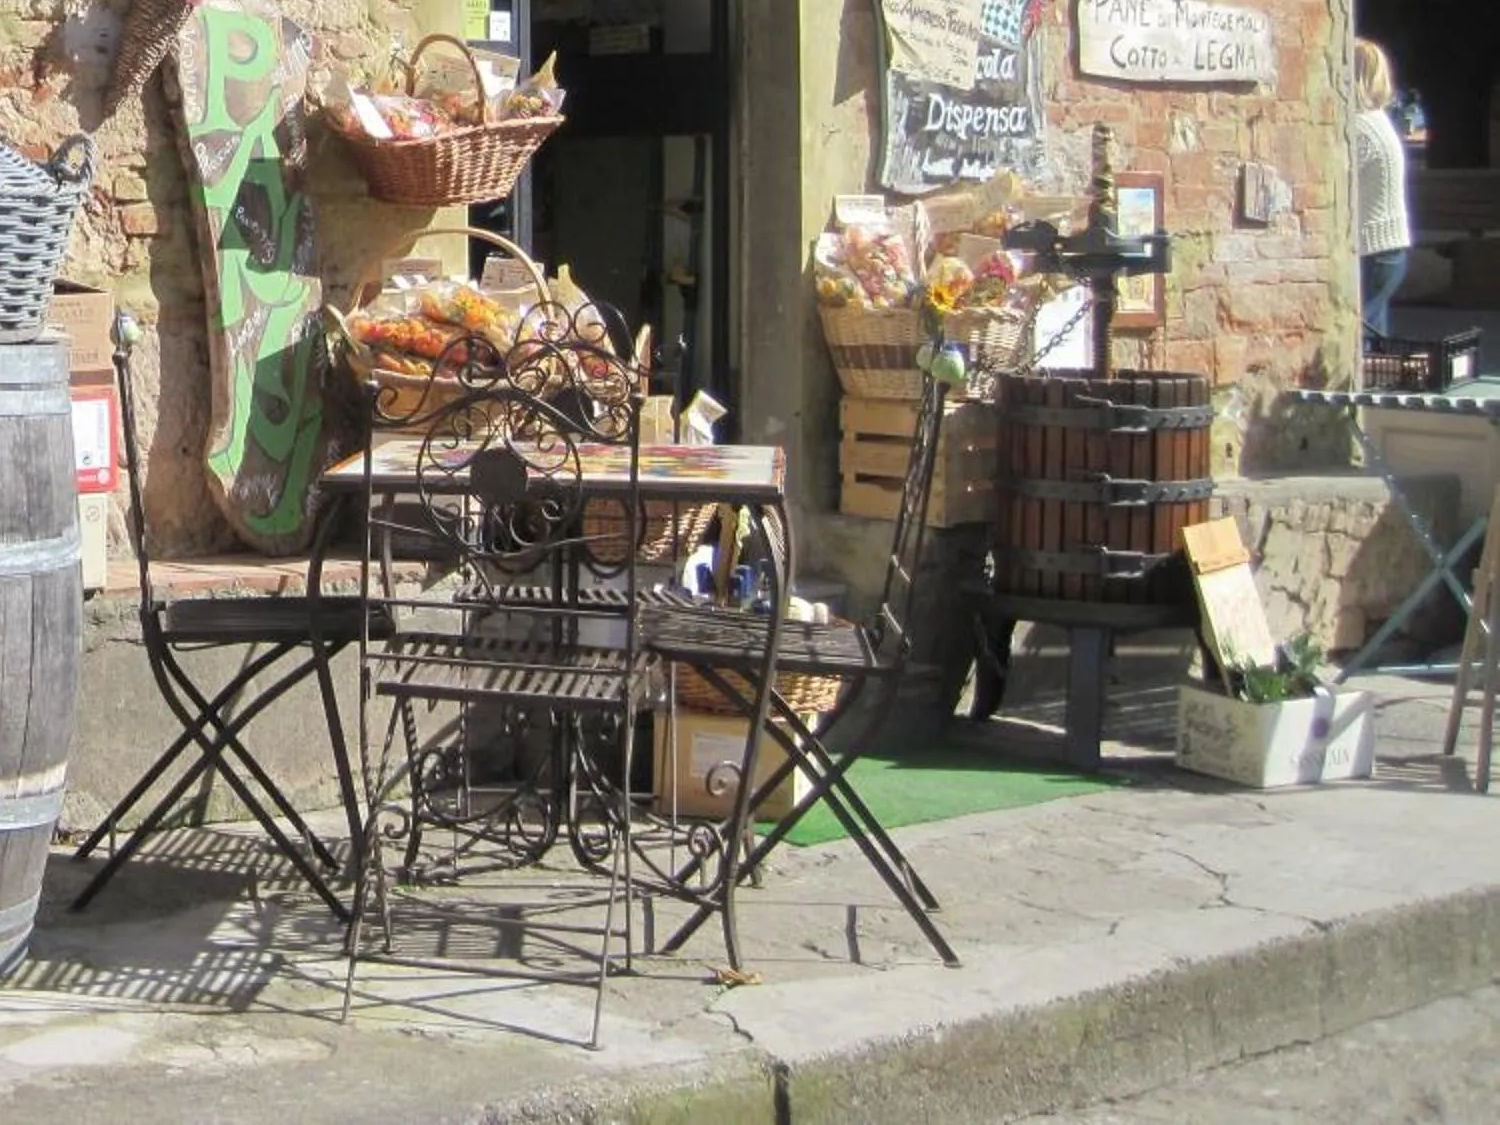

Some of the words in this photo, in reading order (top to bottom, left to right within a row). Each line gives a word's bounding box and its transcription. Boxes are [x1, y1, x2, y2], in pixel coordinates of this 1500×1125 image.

[976, 48, 1017, 80] cola
[1193, 40, 1257, 71] LEGNA
[923, 92, 1028, 140] Dispensa
